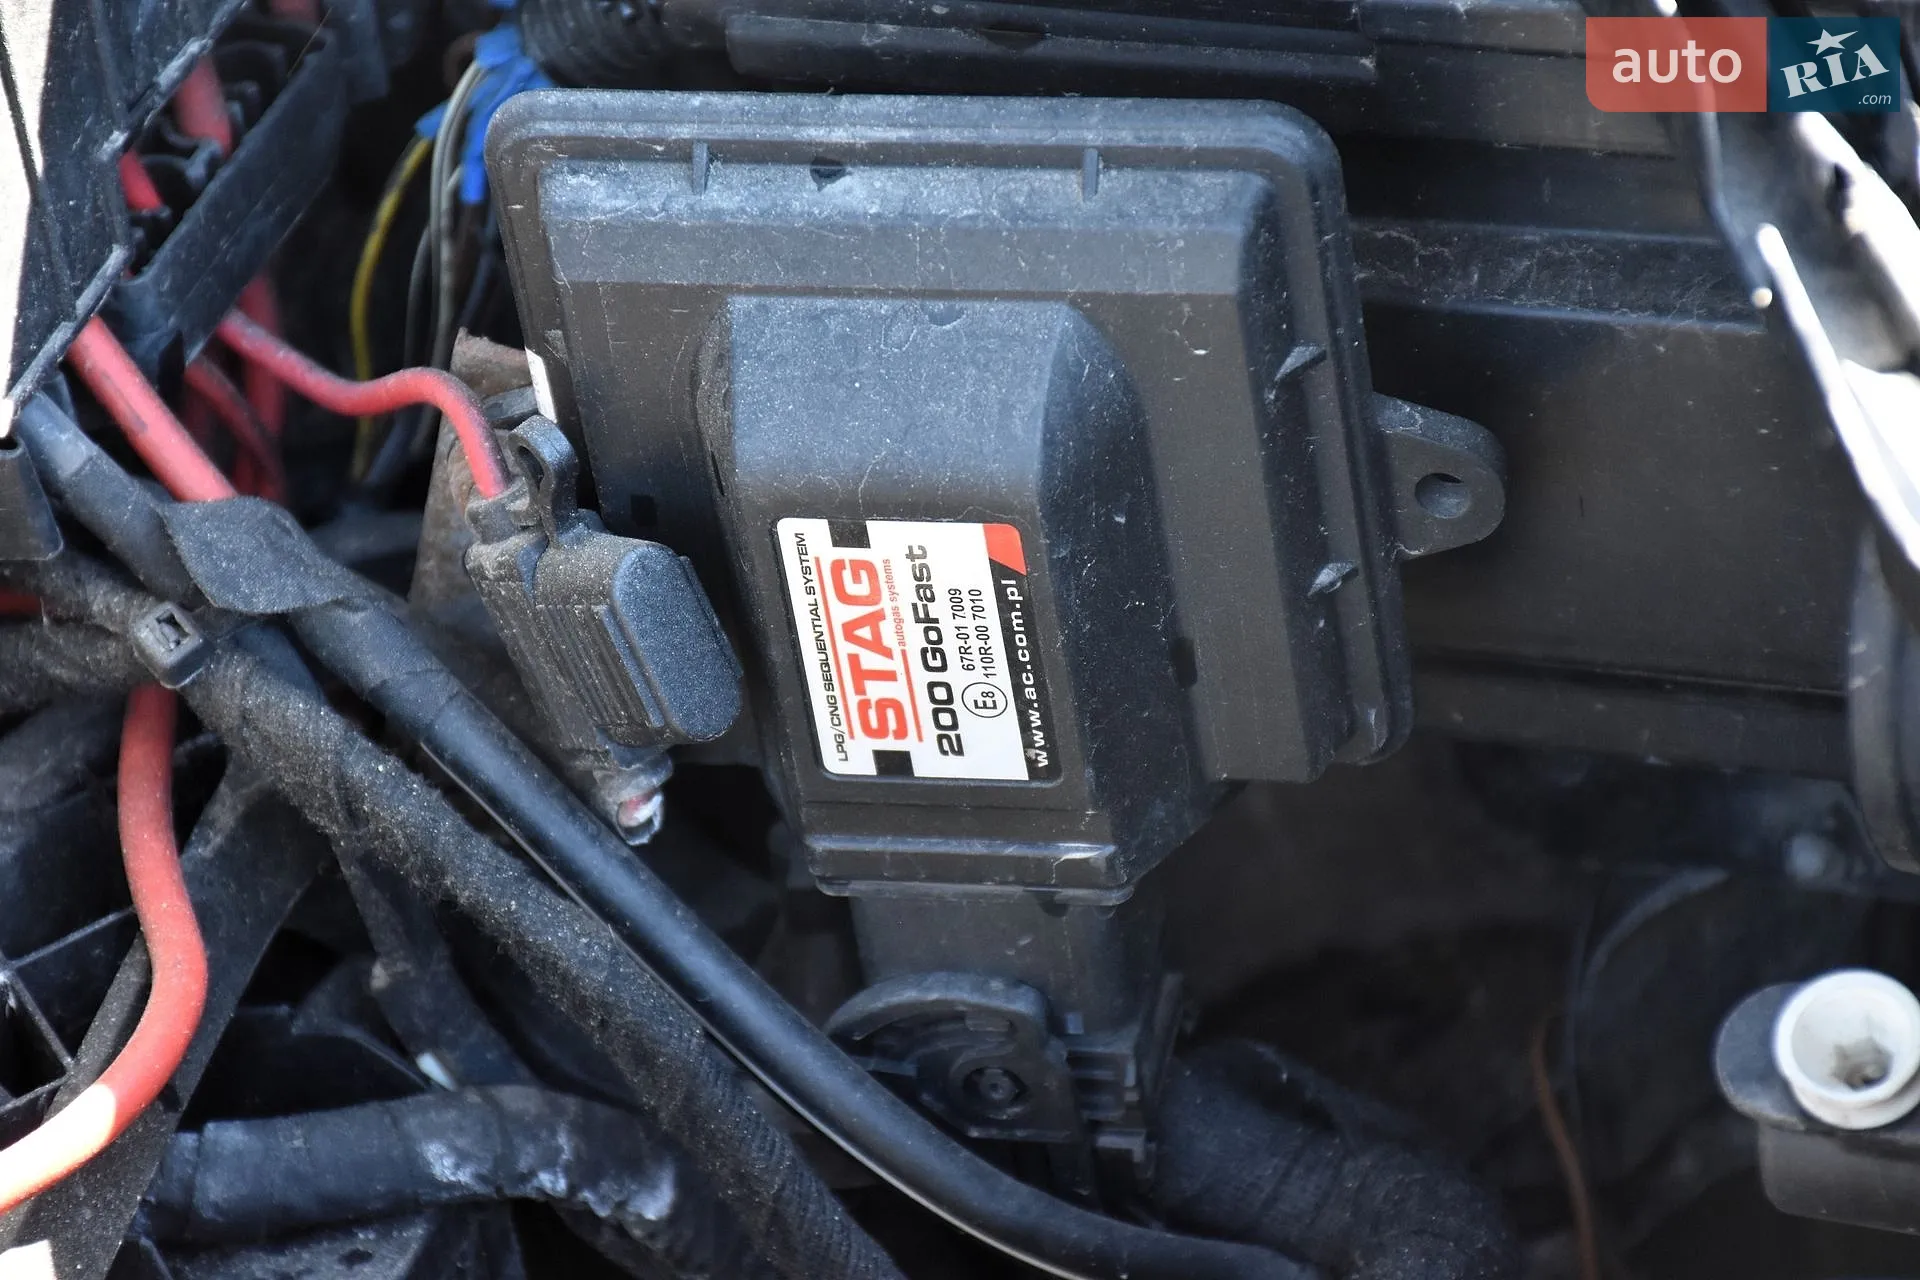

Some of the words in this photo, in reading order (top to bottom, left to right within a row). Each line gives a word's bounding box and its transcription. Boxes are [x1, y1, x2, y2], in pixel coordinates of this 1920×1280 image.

[794, 532, 816, 596] SYSTEM
[882, 558, 900, 602] systems
[891, 605, 907, 647] autogas
[905, 545, 948, 673] GoFast
[947, 588, 967, 620] 7009
[967, 588, 987, 621] 7010
[808, 598, 835, 692] SEQUENTIAL
[830, 558, 908, 741] STAG
[954, 625, 976, 671] 67R-01
[974, 625, 997, 679] 110R-00
[1000, 579, 1049, 768] www.ac.com.pl
[826, 694, 849, 762] LPG/CNG
[926, 681, 965, 757] 200
